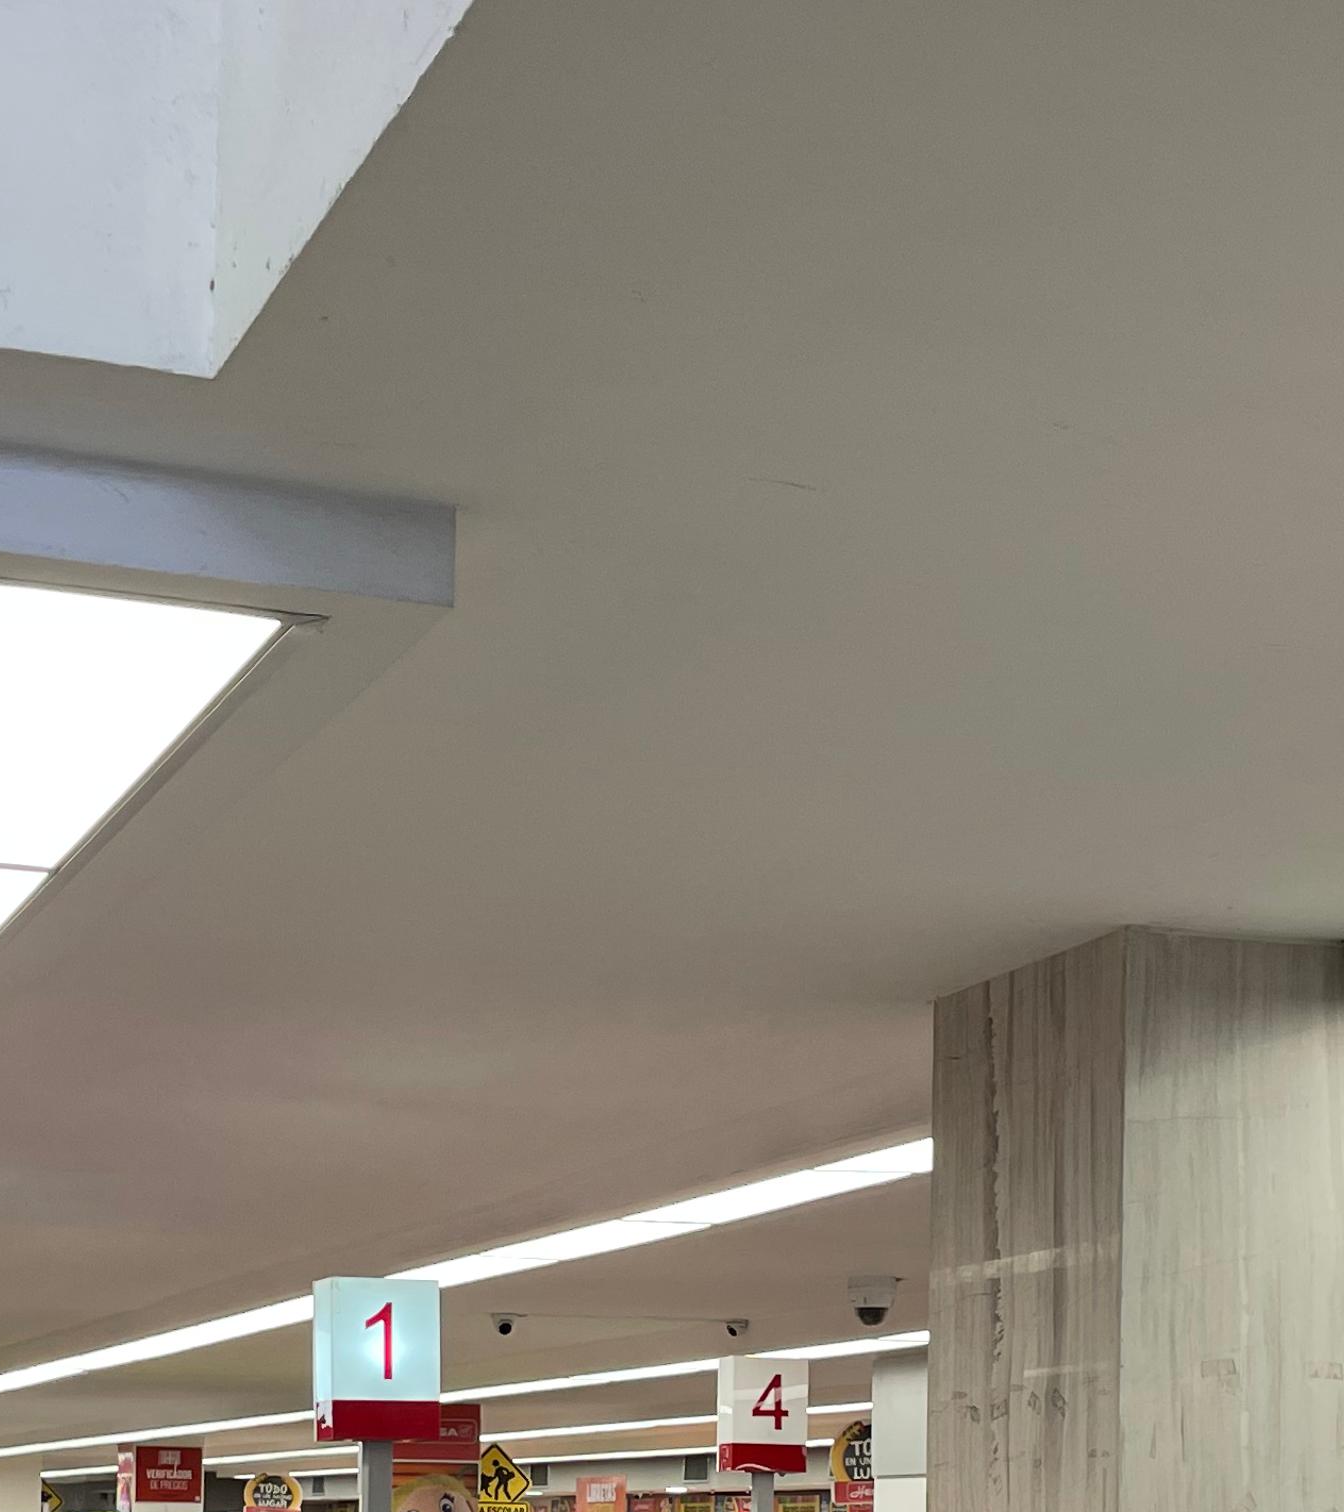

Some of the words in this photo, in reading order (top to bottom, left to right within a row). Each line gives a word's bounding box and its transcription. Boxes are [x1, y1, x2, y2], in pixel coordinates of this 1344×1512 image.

[365, 1302, 393, 1380] 1
[752, 1374, 789, 1431] 4
[146, 1468, 193, 1480] VERIFICADOR
[150, 1481, 159, 1491] DE
[160, 1481, 188, 1491] PRECIOS
[258, 1483, 288, 1494] TODO
